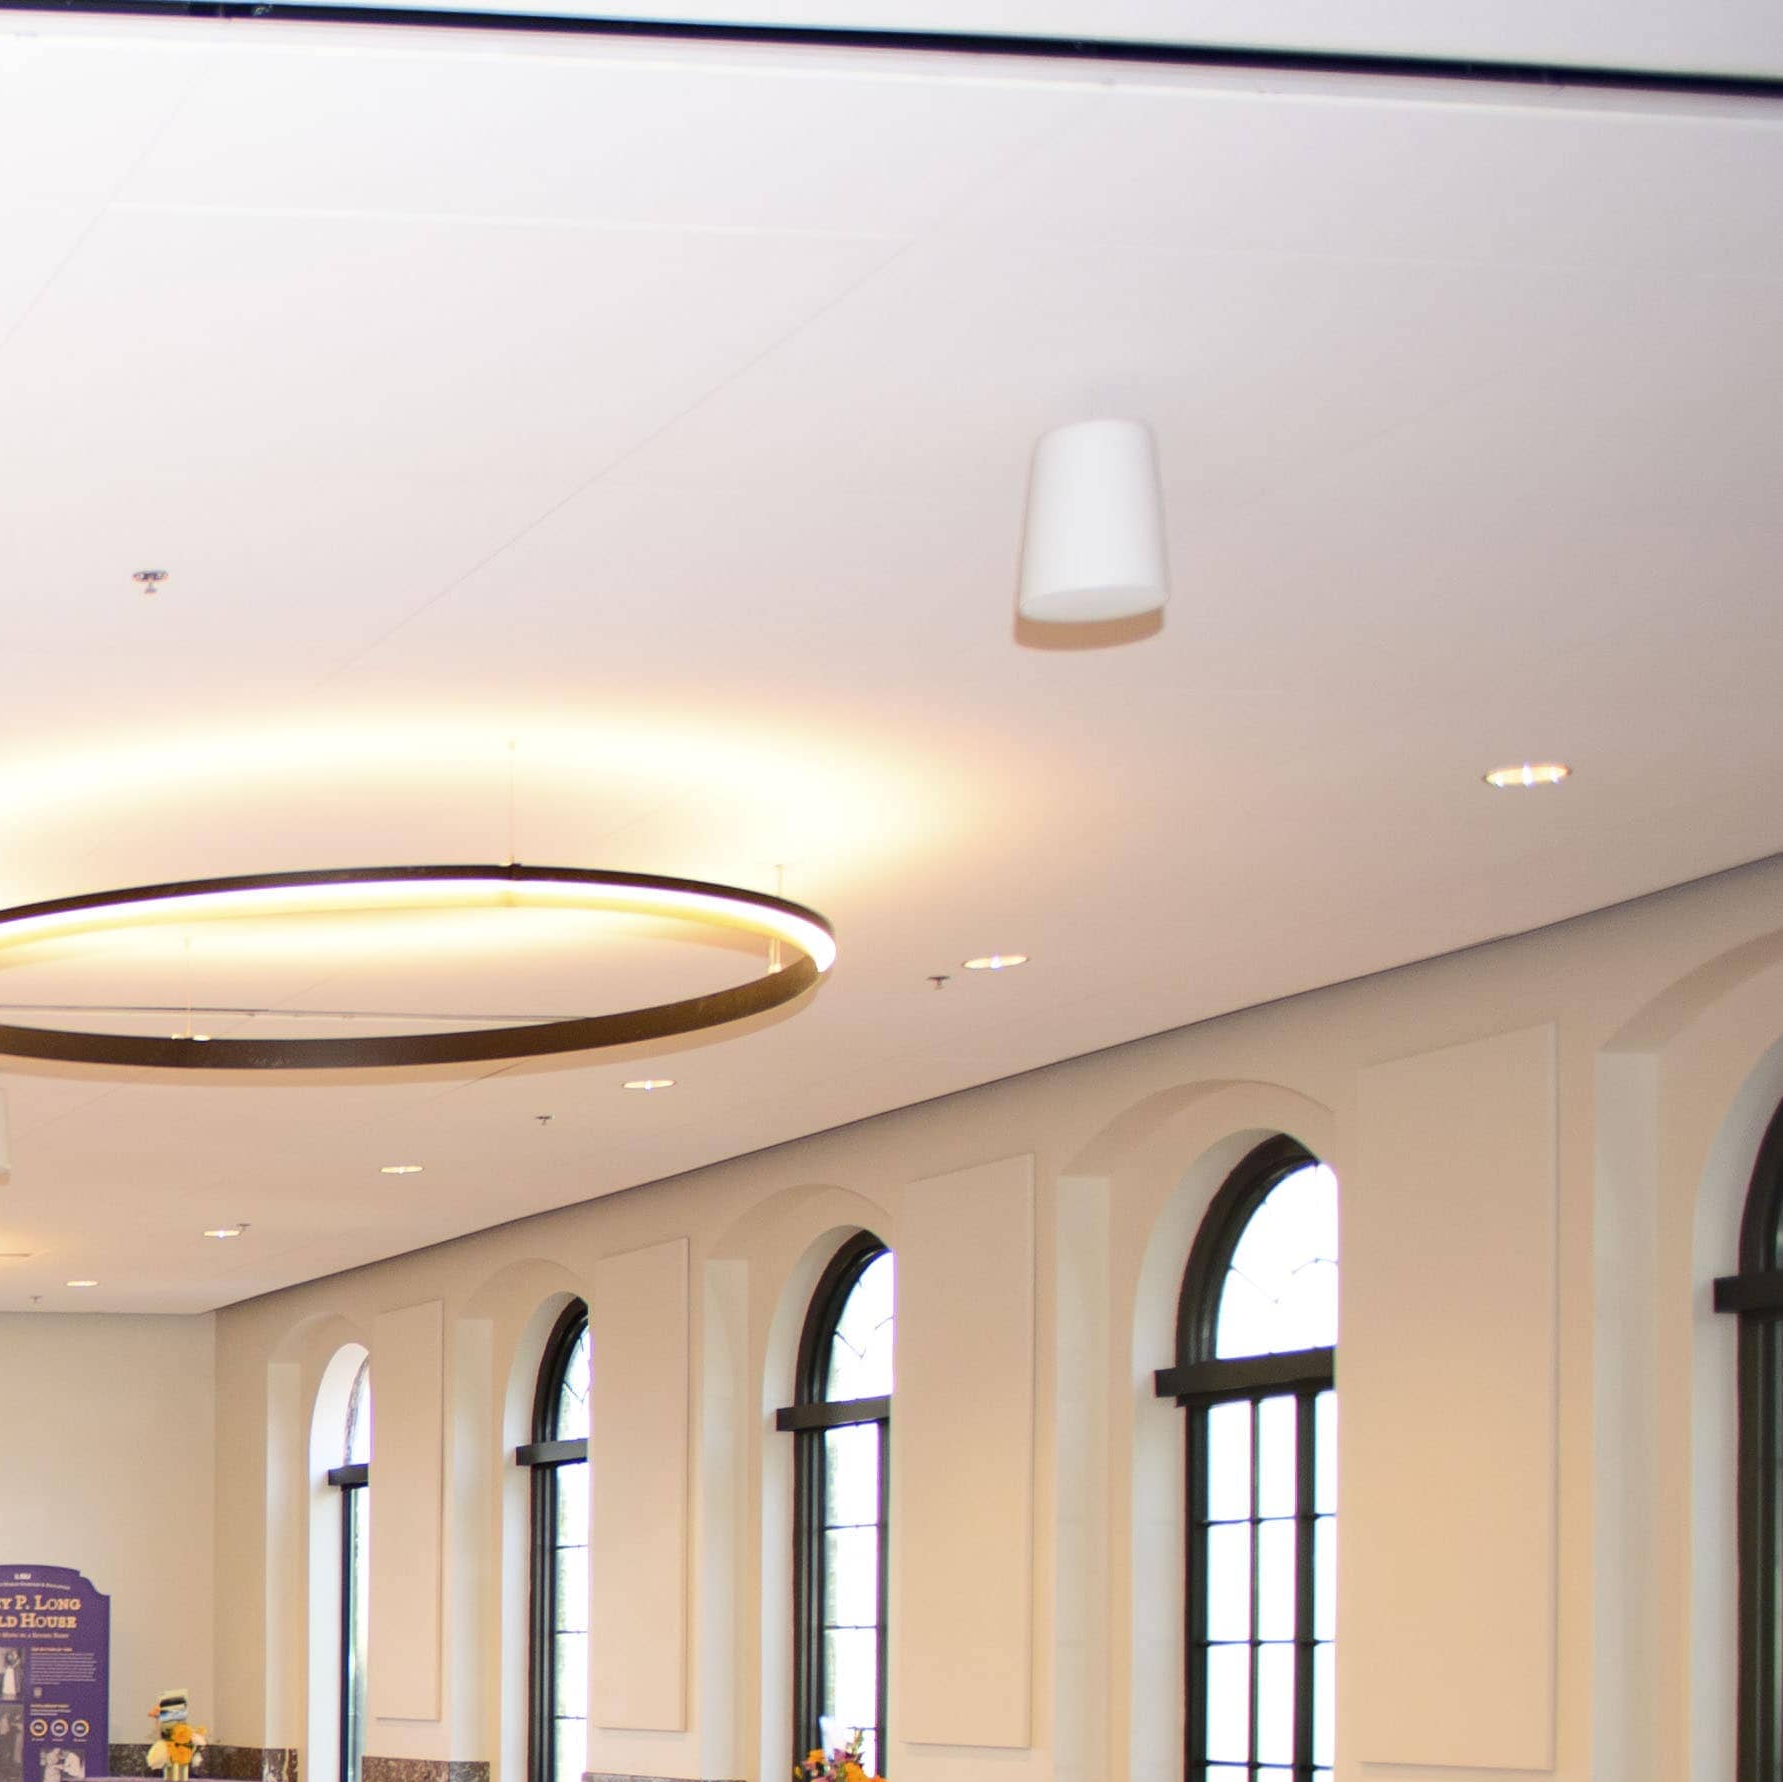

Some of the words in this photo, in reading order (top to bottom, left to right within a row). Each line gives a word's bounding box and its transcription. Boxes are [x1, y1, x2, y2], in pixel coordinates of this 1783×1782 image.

[15, 1594, 30, 1610] P.
[34, 1594, 81, 1611] LONG
[20, 1612, 77, 1628] HOUSE
